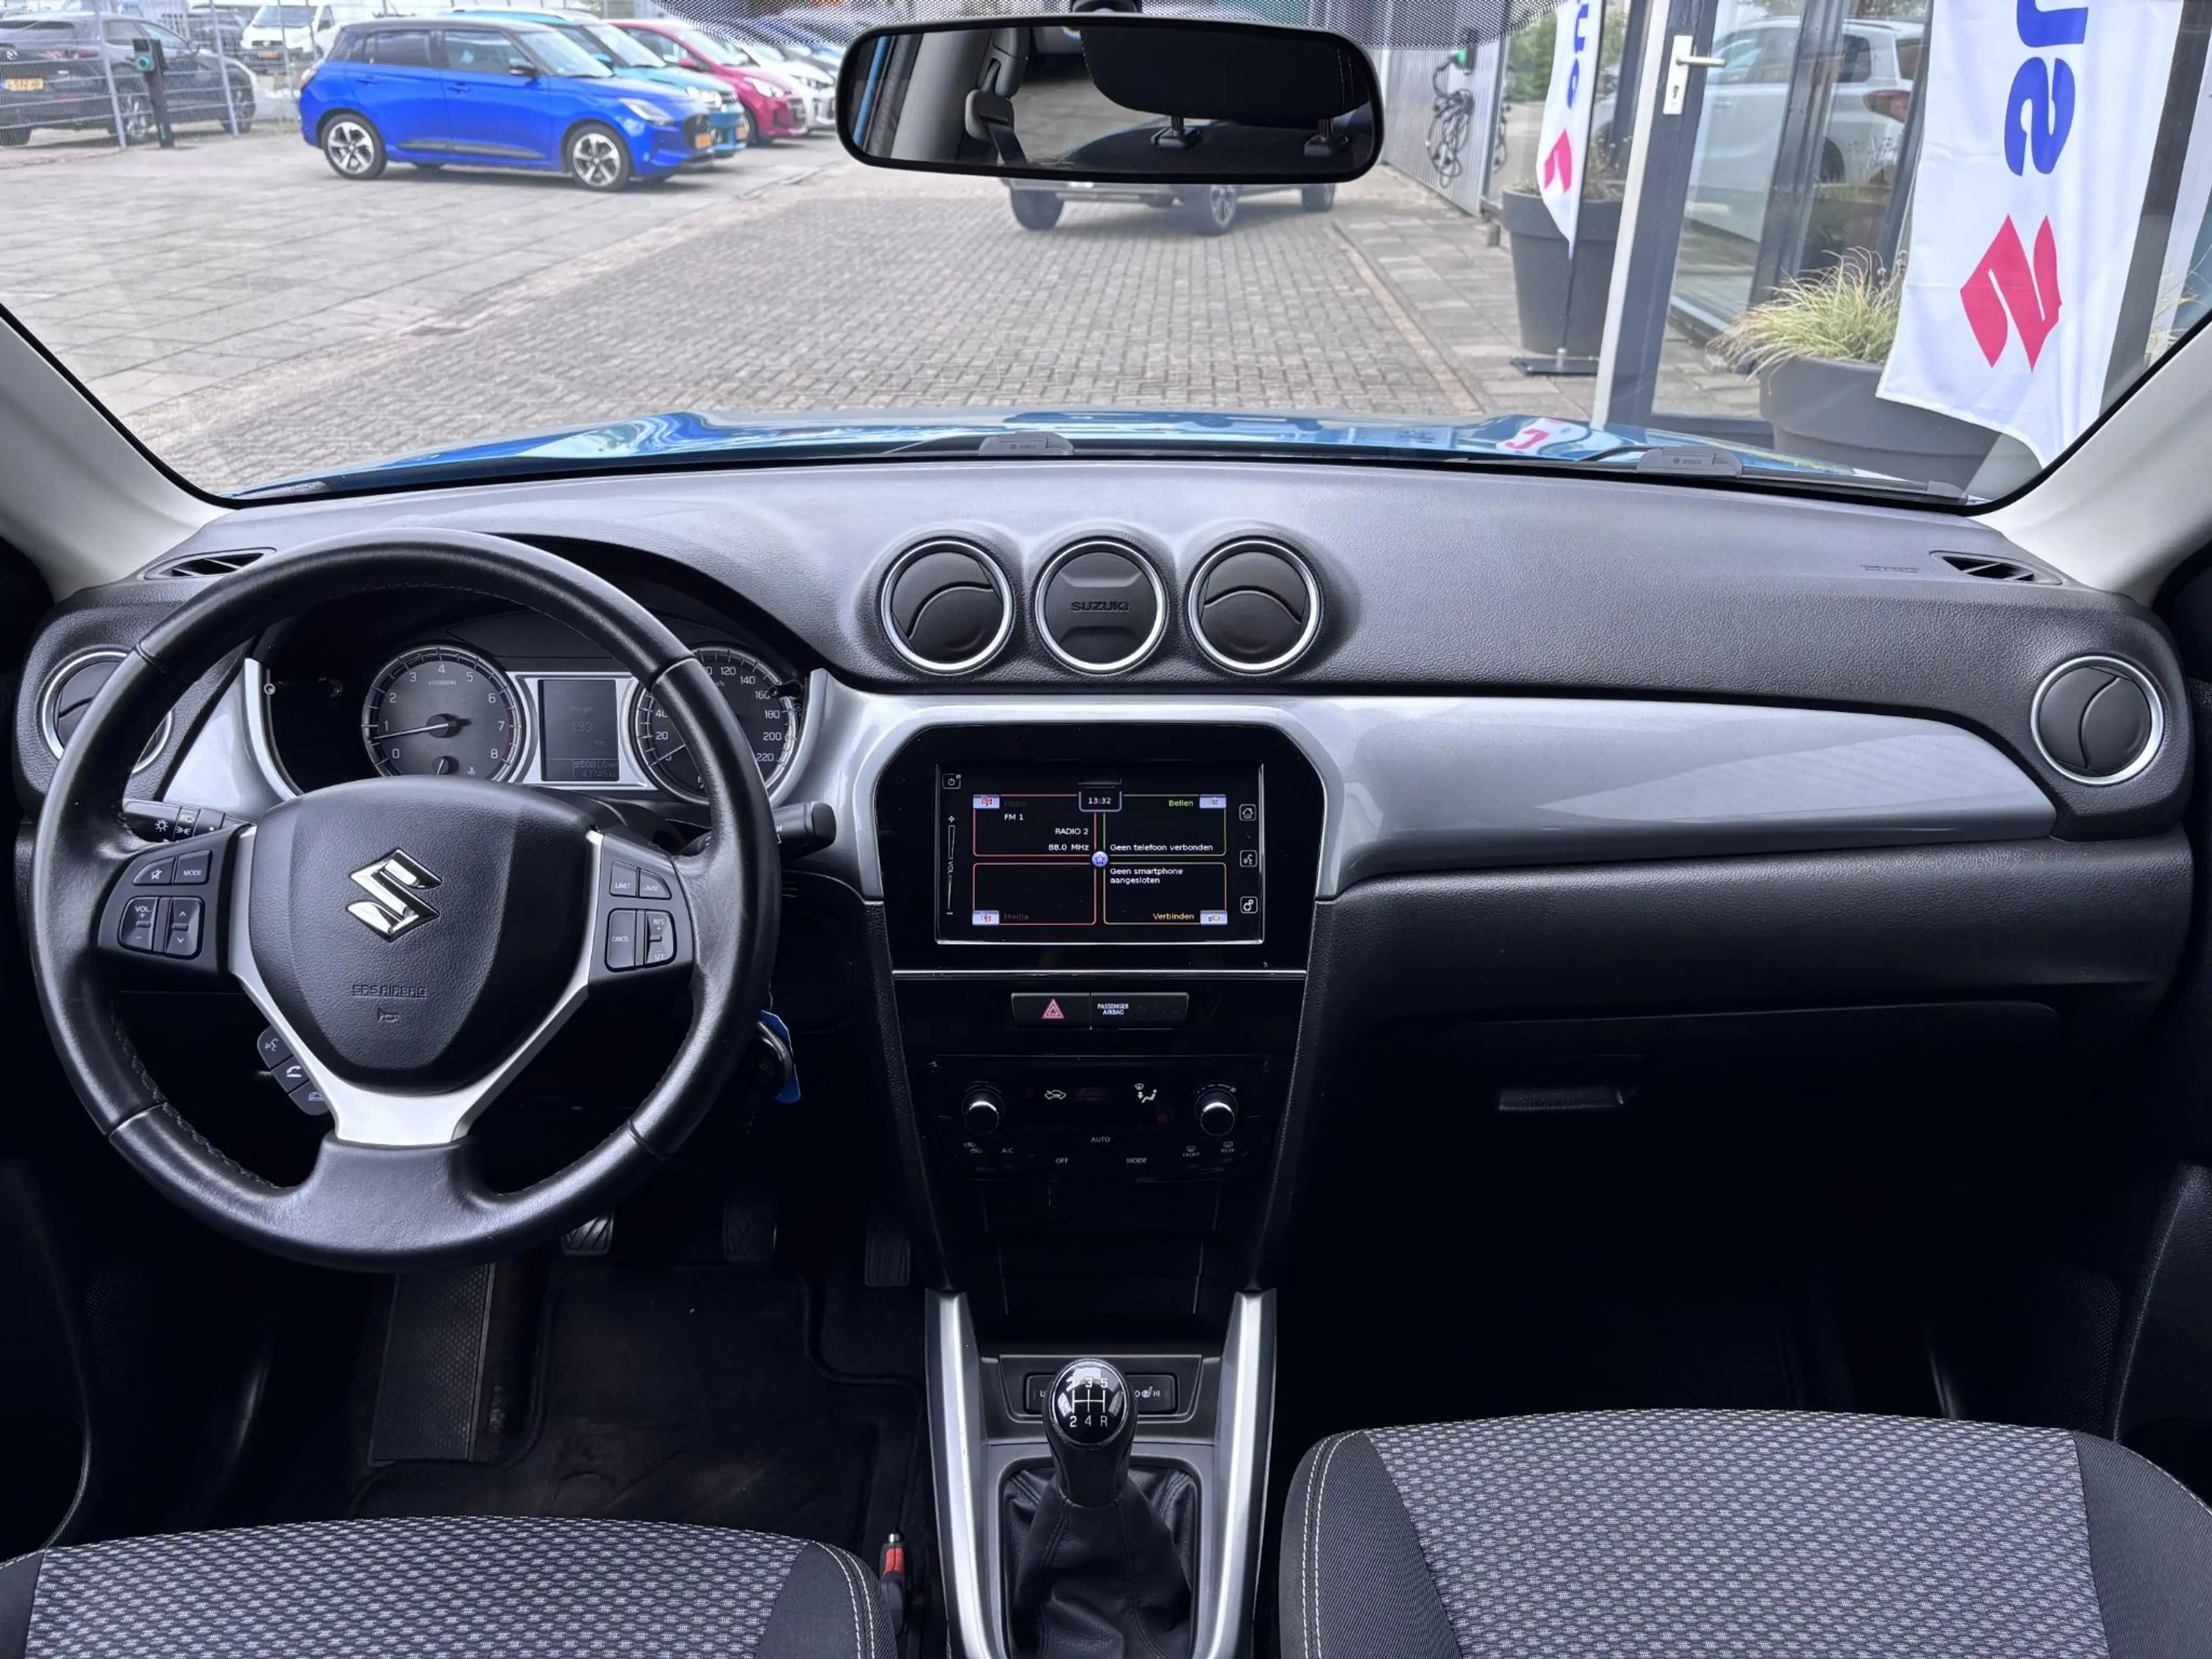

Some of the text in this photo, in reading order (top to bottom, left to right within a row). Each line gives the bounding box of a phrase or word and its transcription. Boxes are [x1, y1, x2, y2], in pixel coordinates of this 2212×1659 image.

[1071, 601, 1130, 612] SUZUKI
[438, 664, 445, 674] 4
[720, 666, 736, 675] 120
[410, 672, 417, 682] 3
[466, 672, 474, 682] 5
[740, 676, 756, 685] 140
[389, 693, 396, 703] 2
[488, 694, 495, 703] 6
[764, 710, 779, 718] 180
[384, 721, 388, 730] 1
[498, 721, 505, 731] 7
[656, 731, 668, 740] 20
[763, 732, 782, 741] 200
[392, 748, 400, 759] 0
[491, 749, 498, 759] 8
[756, 752, 774, 762] 220
[1088, 797, 1111, 805] 13:32
[1169, 799, 1194, 807] Bellen
[183, 869, 203, 877] MODE
[1134, 868, 1184, 877] smartphone
[1110, 876, 1160, 885] aangesloten
[1153, 912, 1194, 921] Verbinden
[380, 986, 427, 997] AIRBAG
[1084, 1377, 1093, 1388] 3
[1100, 1378, 1108, 1388] 5
[1069, 1415, 1108, 1427] 2 4 R
